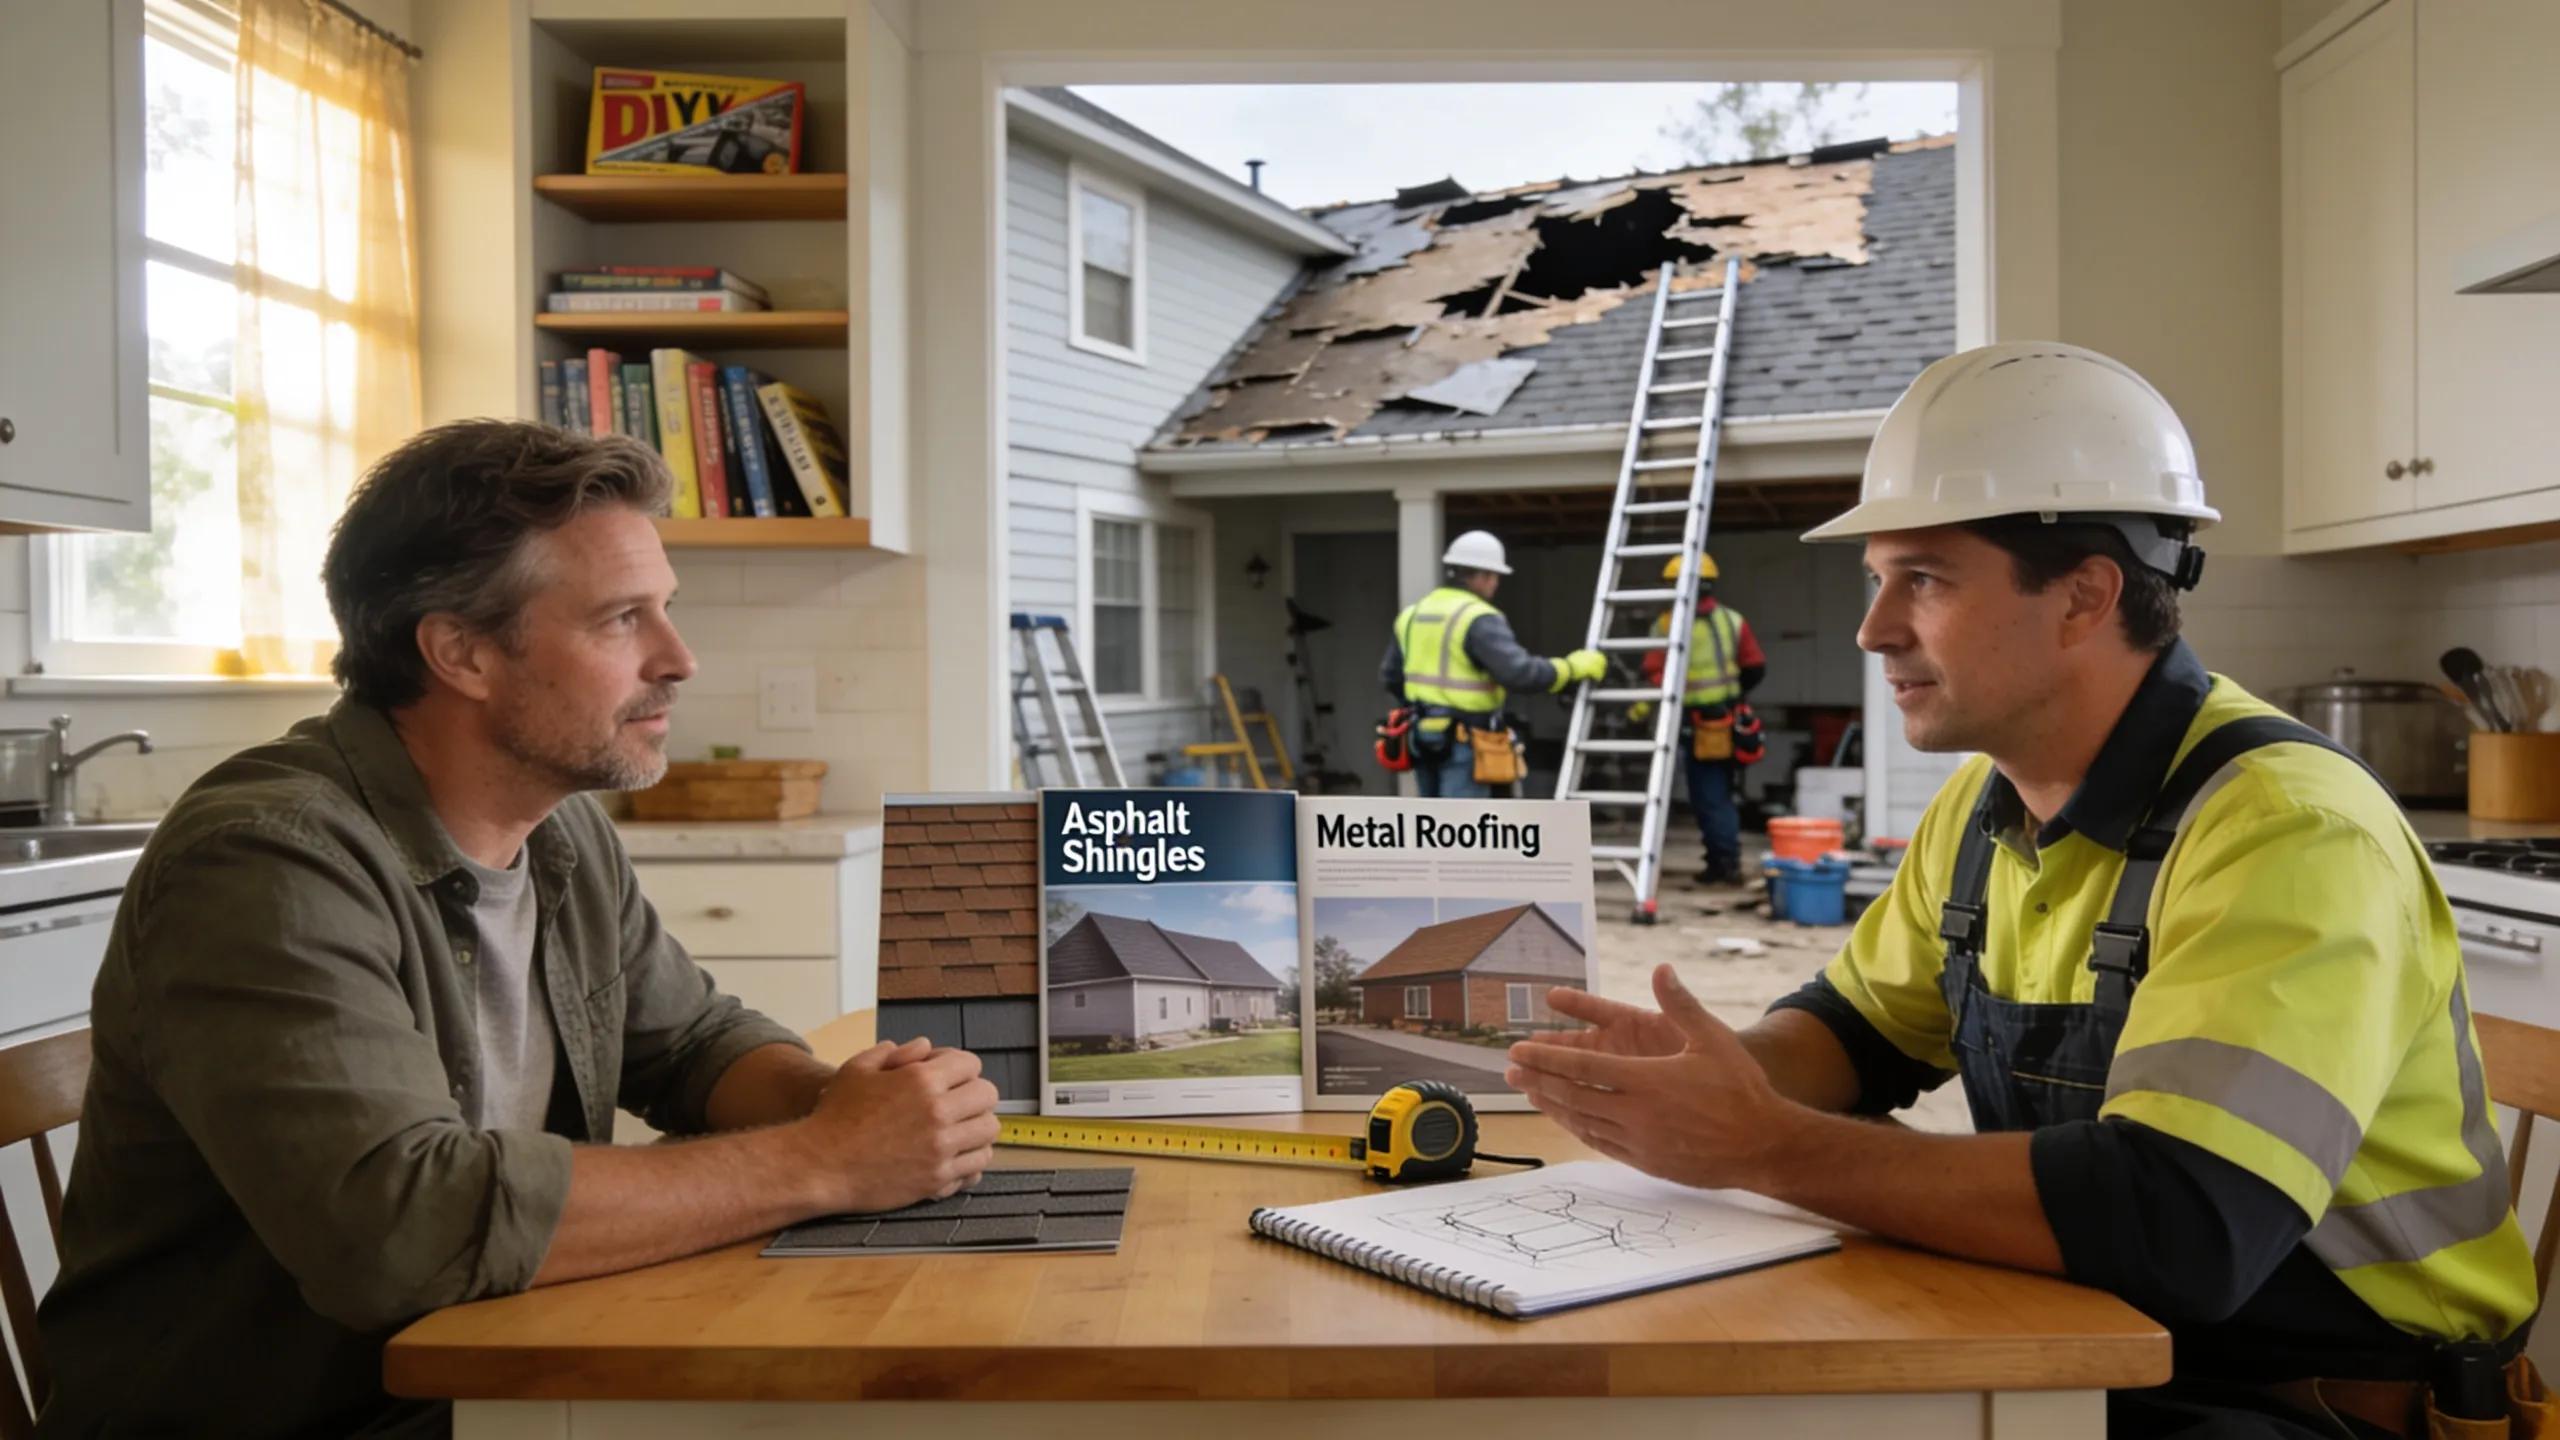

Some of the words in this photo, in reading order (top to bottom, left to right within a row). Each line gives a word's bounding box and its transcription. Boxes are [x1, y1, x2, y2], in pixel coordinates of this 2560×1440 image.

[1062, 801, 1191, 846] Asphalt
[1317, 813, 1405, 848] Metal
[1415, 813, 1540, 857] Roofing
[1063, 838, 1206, 881] Shingles
